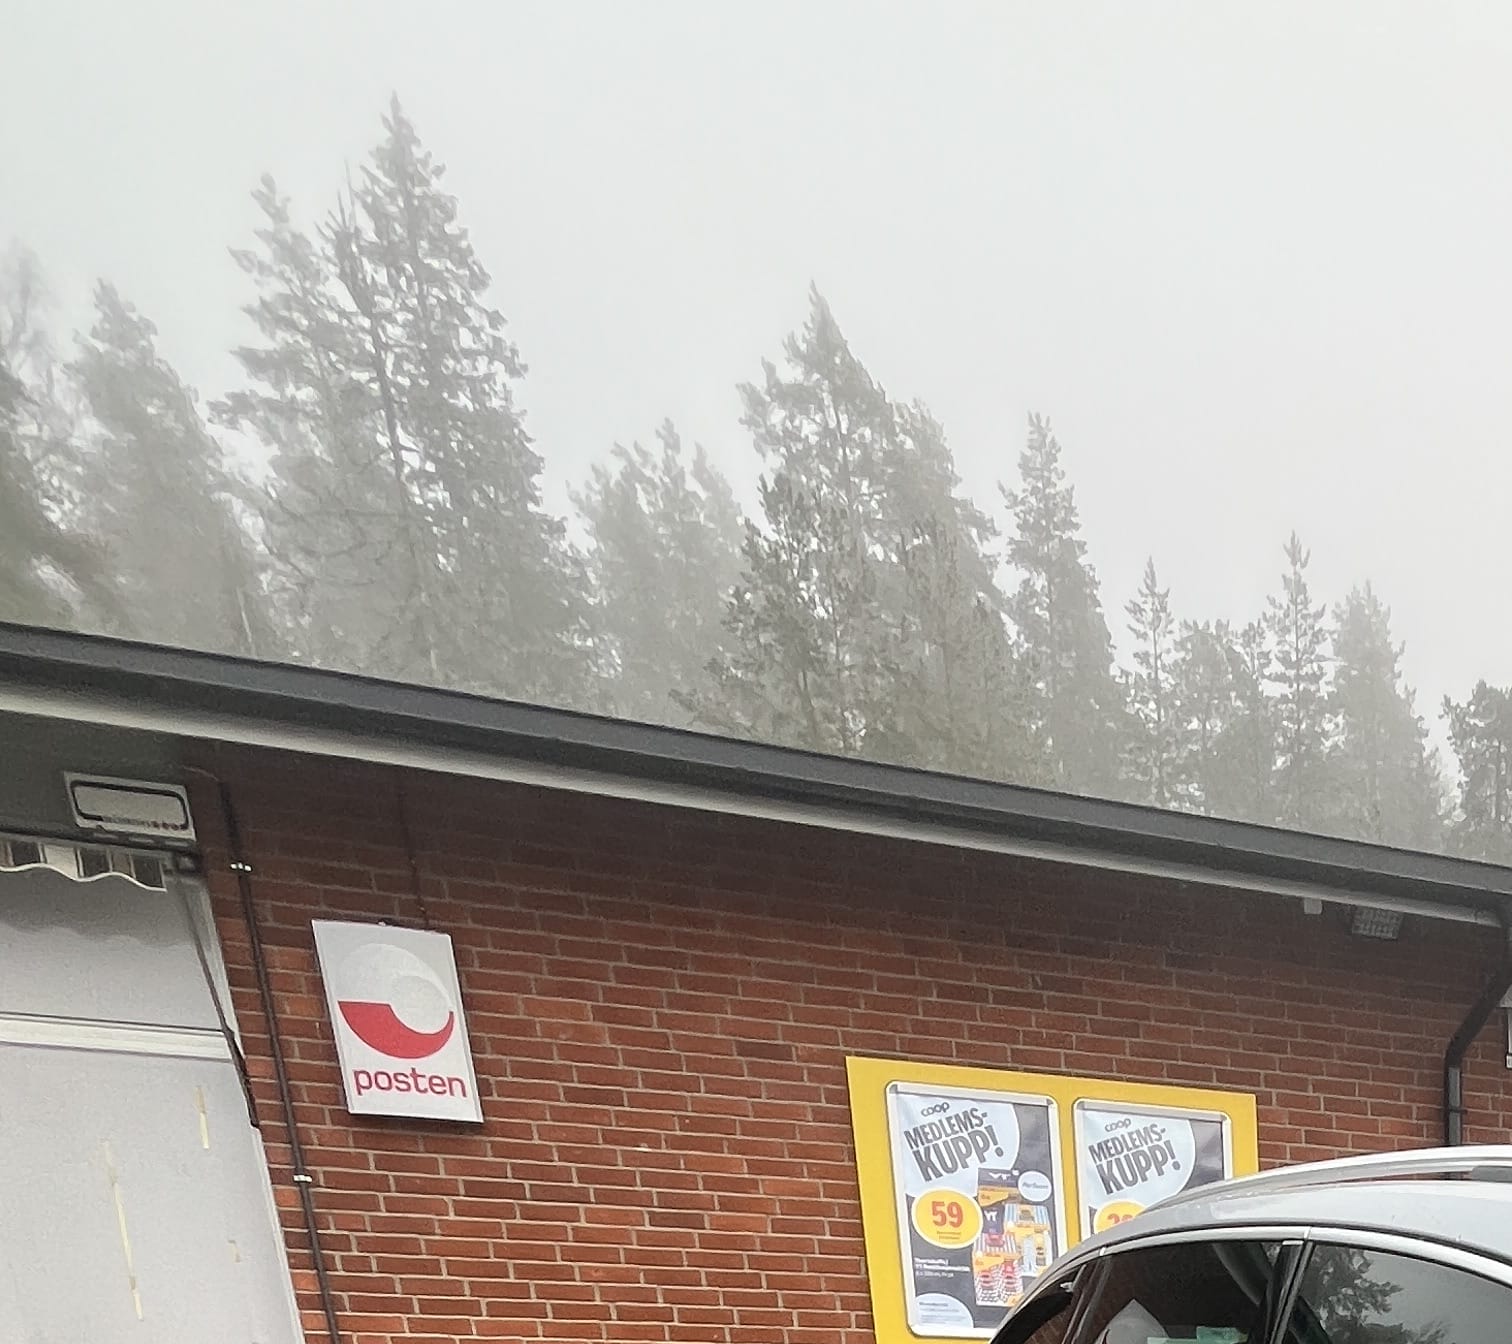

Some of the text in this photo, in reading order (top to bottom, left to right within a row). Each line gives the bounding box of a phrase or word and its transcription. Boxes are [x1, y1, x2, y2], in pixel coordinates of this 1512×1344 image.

[353, 1066, 467, 1097] posten
[921, 1101, 950, 1117] coop
[1104, 1118, 1131, 1133] coop
[904, 1107, 988, 1150] MEDLEMS-
[1088, 1123, 1166, 1164] MEDLEMS-
[912, 1125, 1004, 1182] KUPP!
[1096, 1140, 1181, 1195] KUPP!
[931, 1201, 964, 1228] 59
